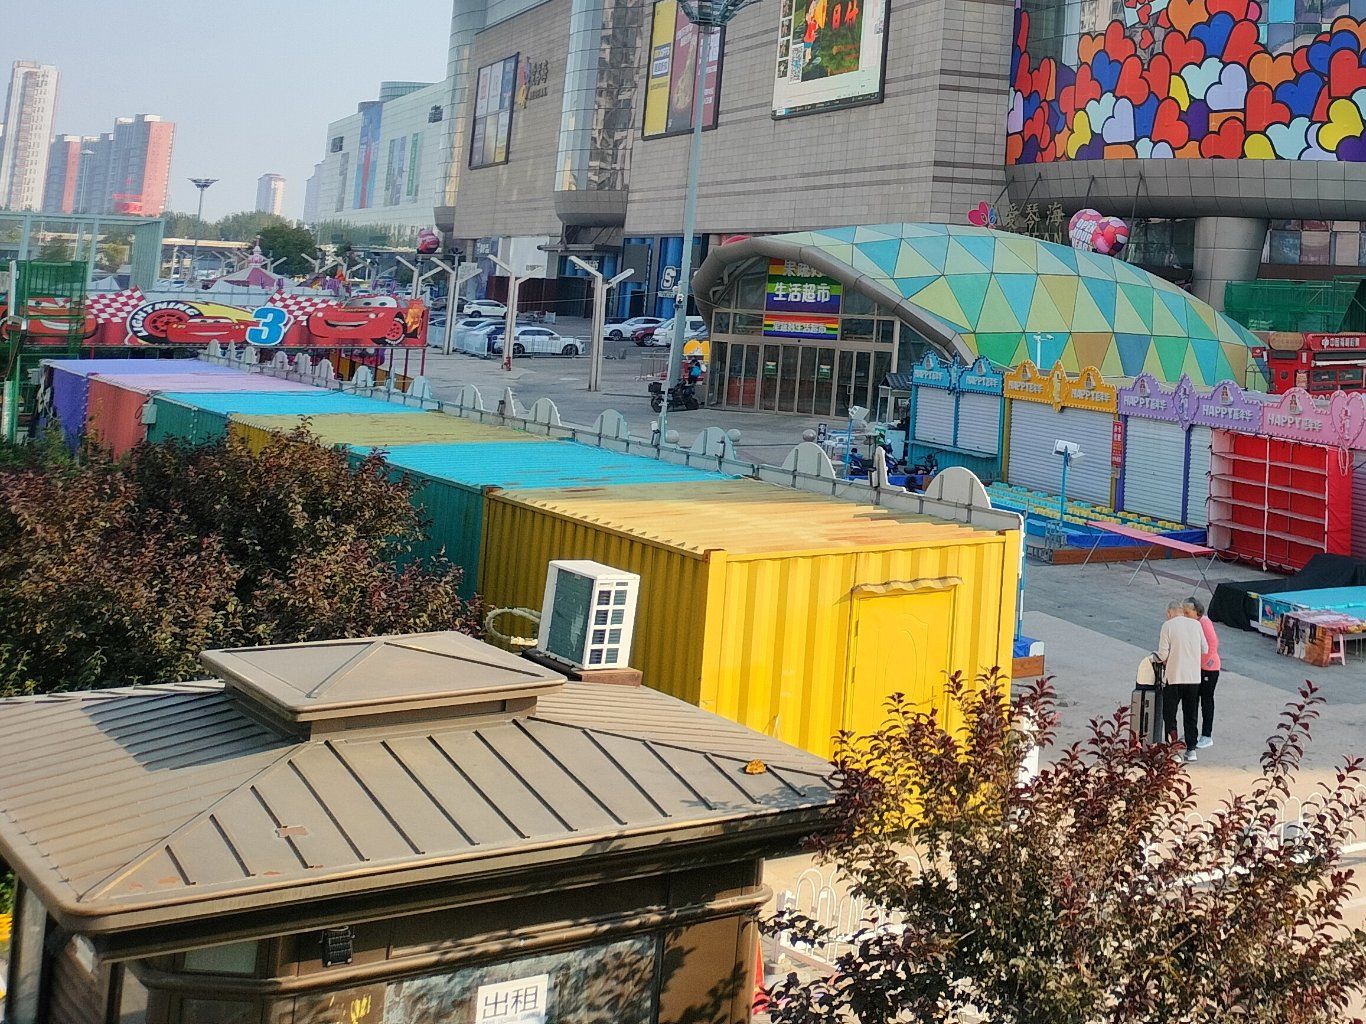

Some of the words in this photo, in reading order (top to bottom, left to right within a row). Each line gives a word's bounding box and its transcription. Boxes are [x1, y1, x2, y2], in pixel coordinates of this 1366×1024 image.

[773, 282, 831, 302] 生活超市
[131, 302, 200, 338] LIGHTNING
[247, 306, 287, 345] 3
[482, 985, 540, 1019] 出租
